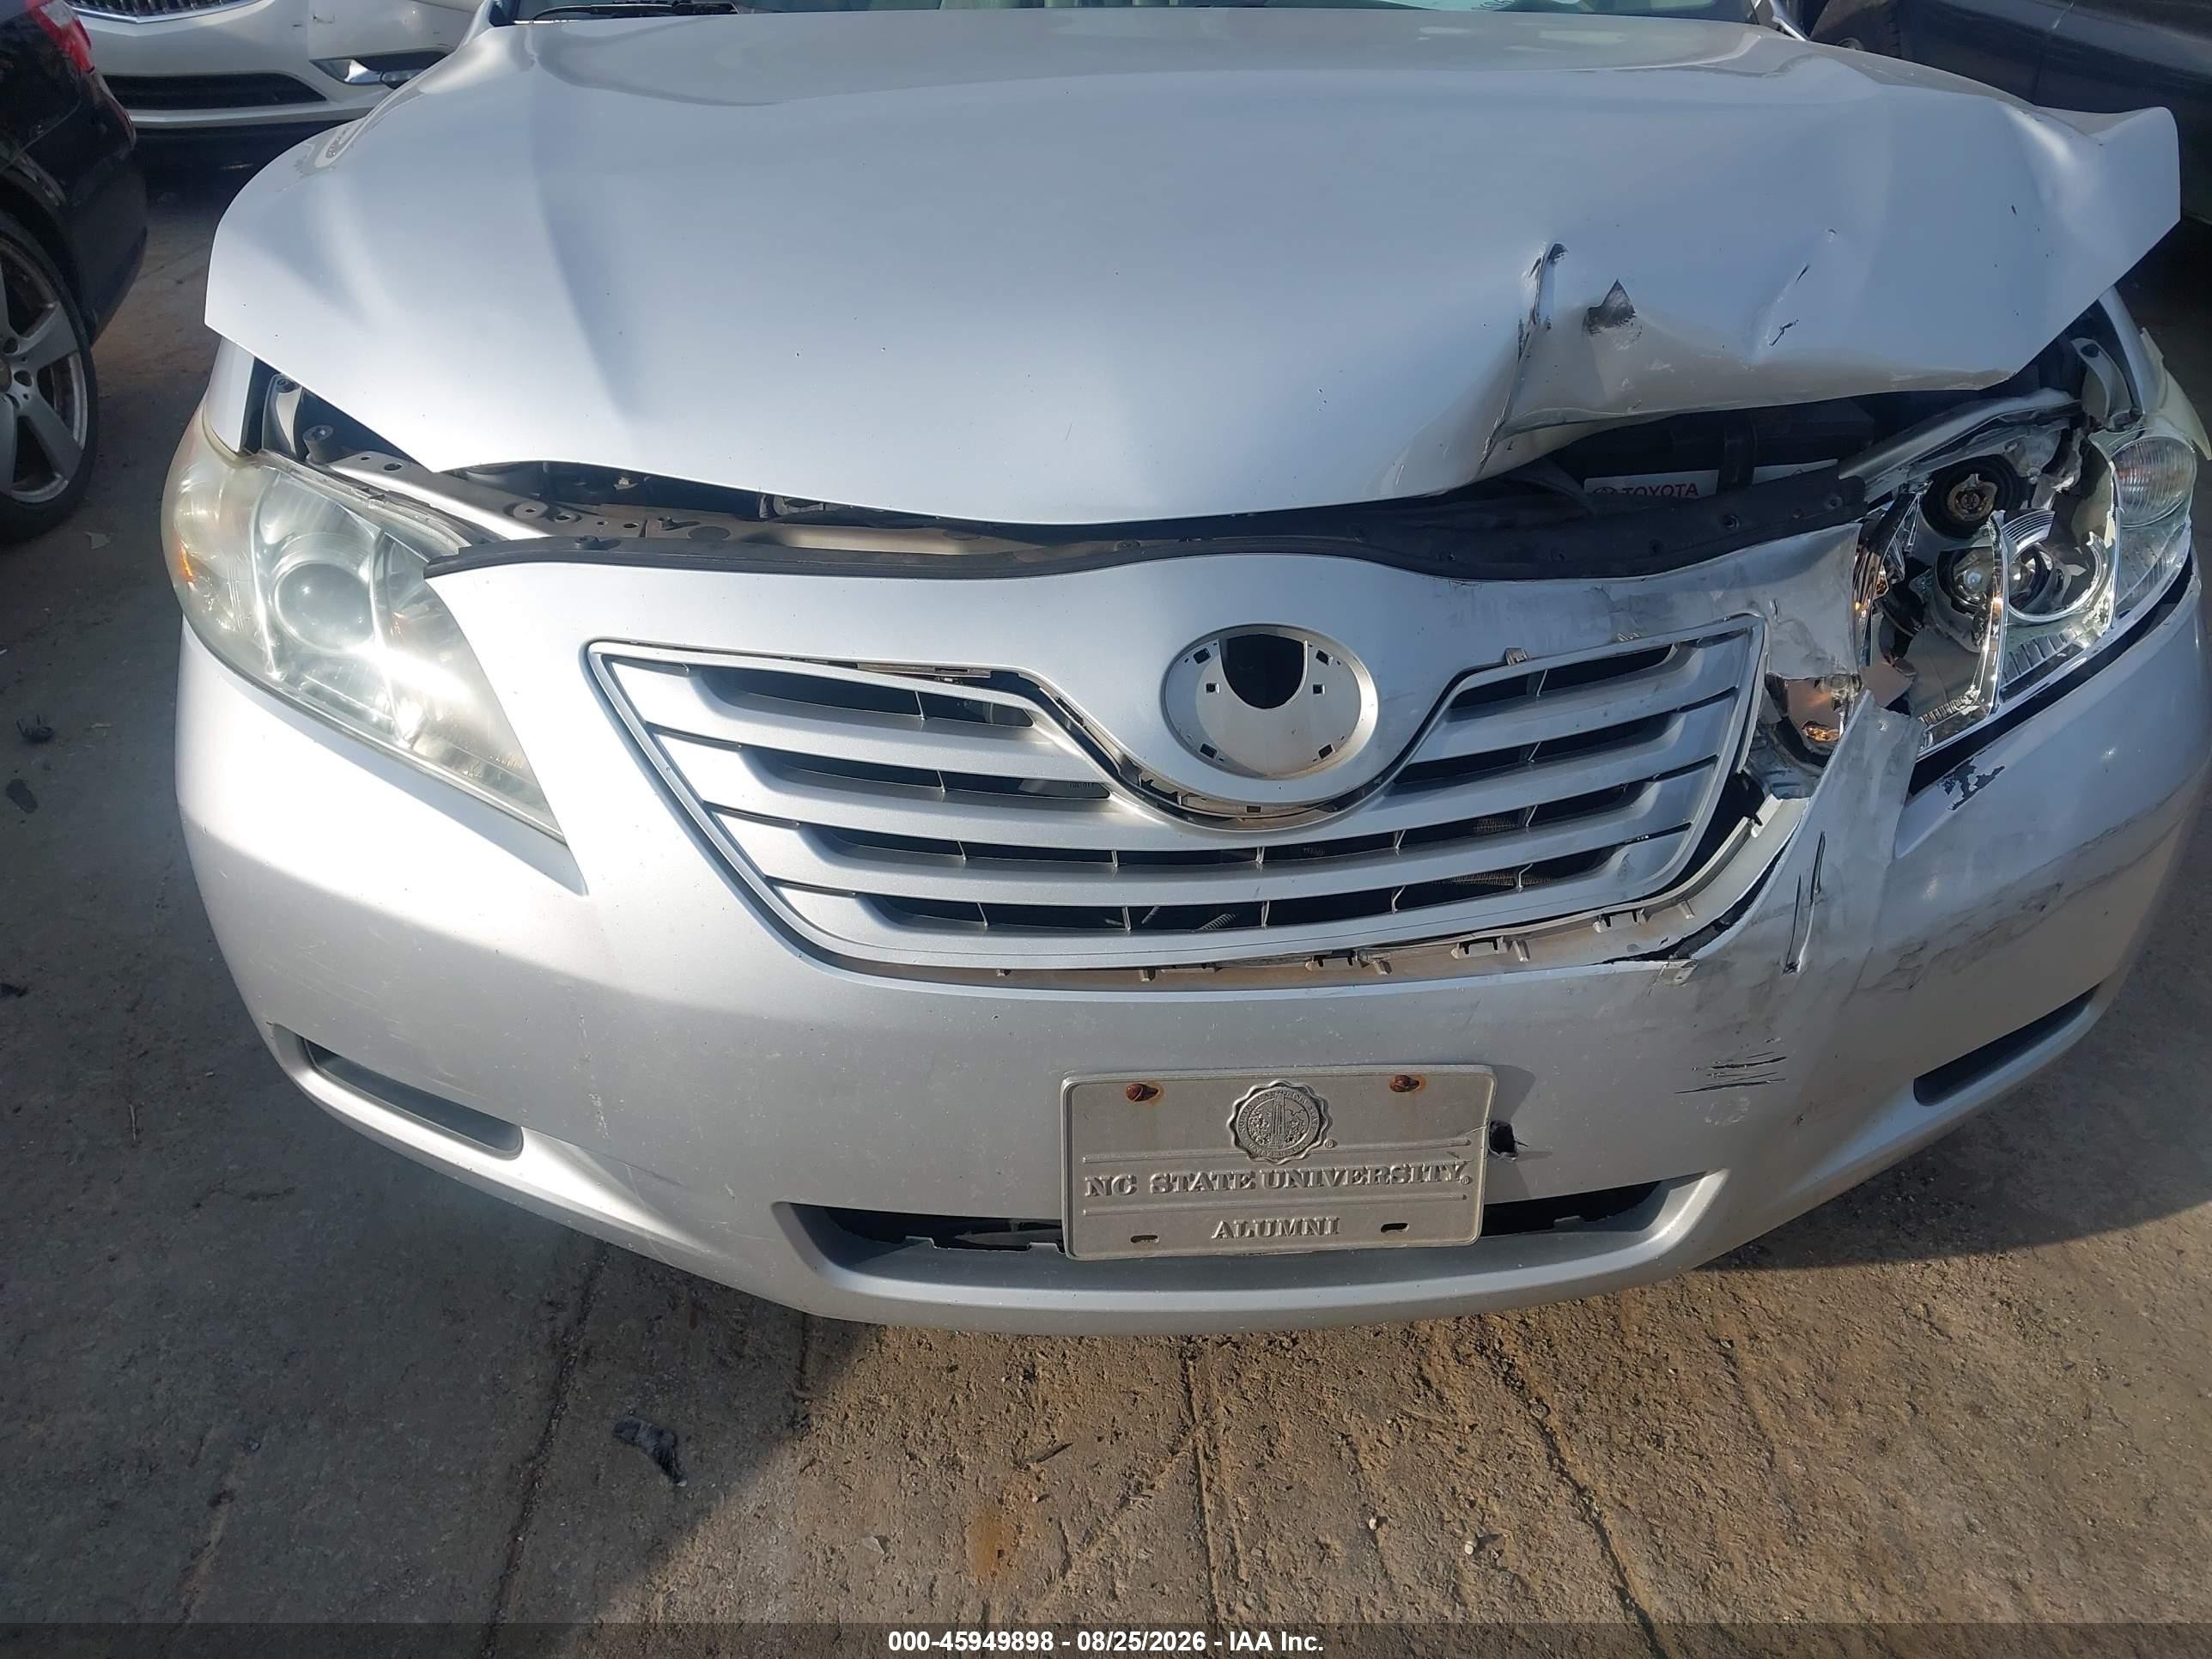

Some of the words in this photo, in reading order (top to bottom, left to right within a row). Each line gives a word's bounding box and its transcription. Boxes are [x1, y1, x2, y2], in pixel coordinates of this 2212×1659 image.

[1622, 483, 1699, 496] TOYOTA
[1085, 1174, 1137, 1197] NC
[1149, 1170, 1256, 1194] STATE
[1210, 1217, 1340, 1240] ALUMNI
